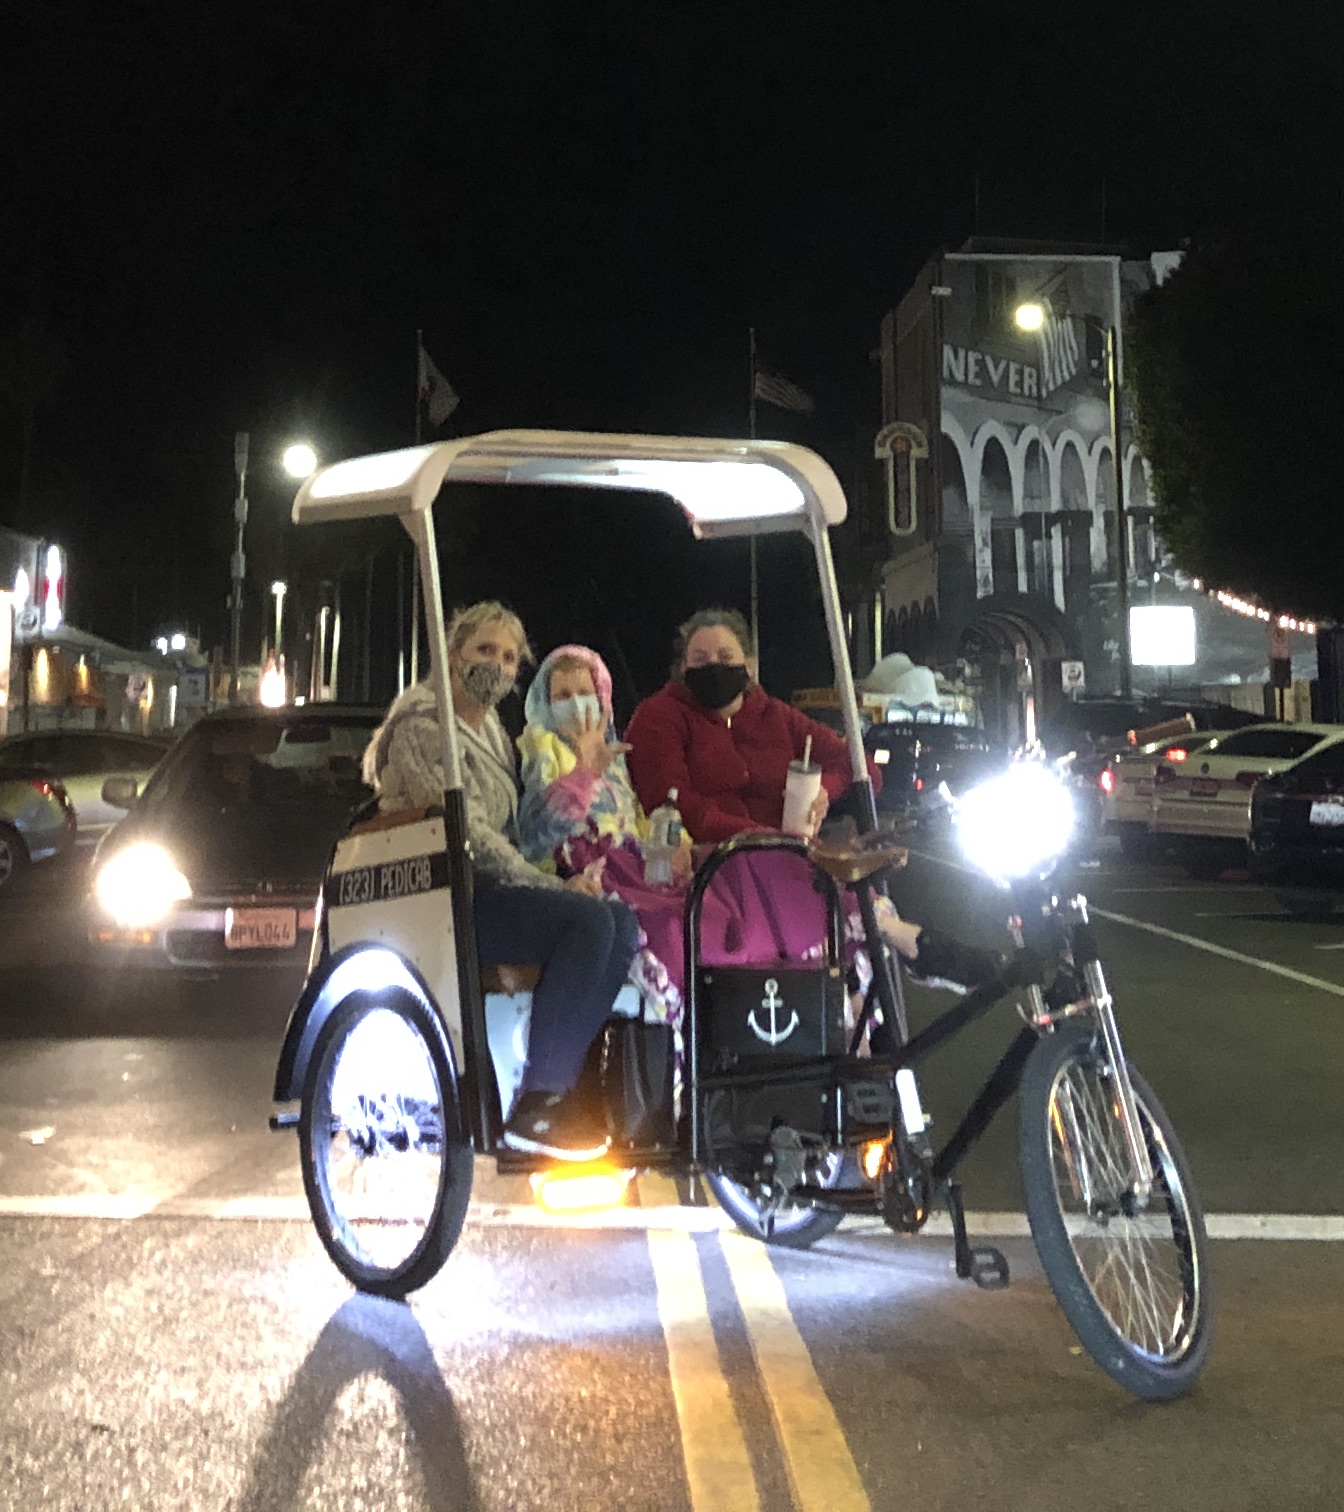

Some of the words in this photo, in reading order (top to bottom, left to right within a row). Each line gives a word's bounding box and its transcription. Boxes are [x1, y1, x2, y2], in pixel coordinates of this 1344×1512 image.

[942, 344, 1039, 399] NEVER
[339, 867, 375, 905] (323)
[380, 855, 433, 896] PEDICAB
